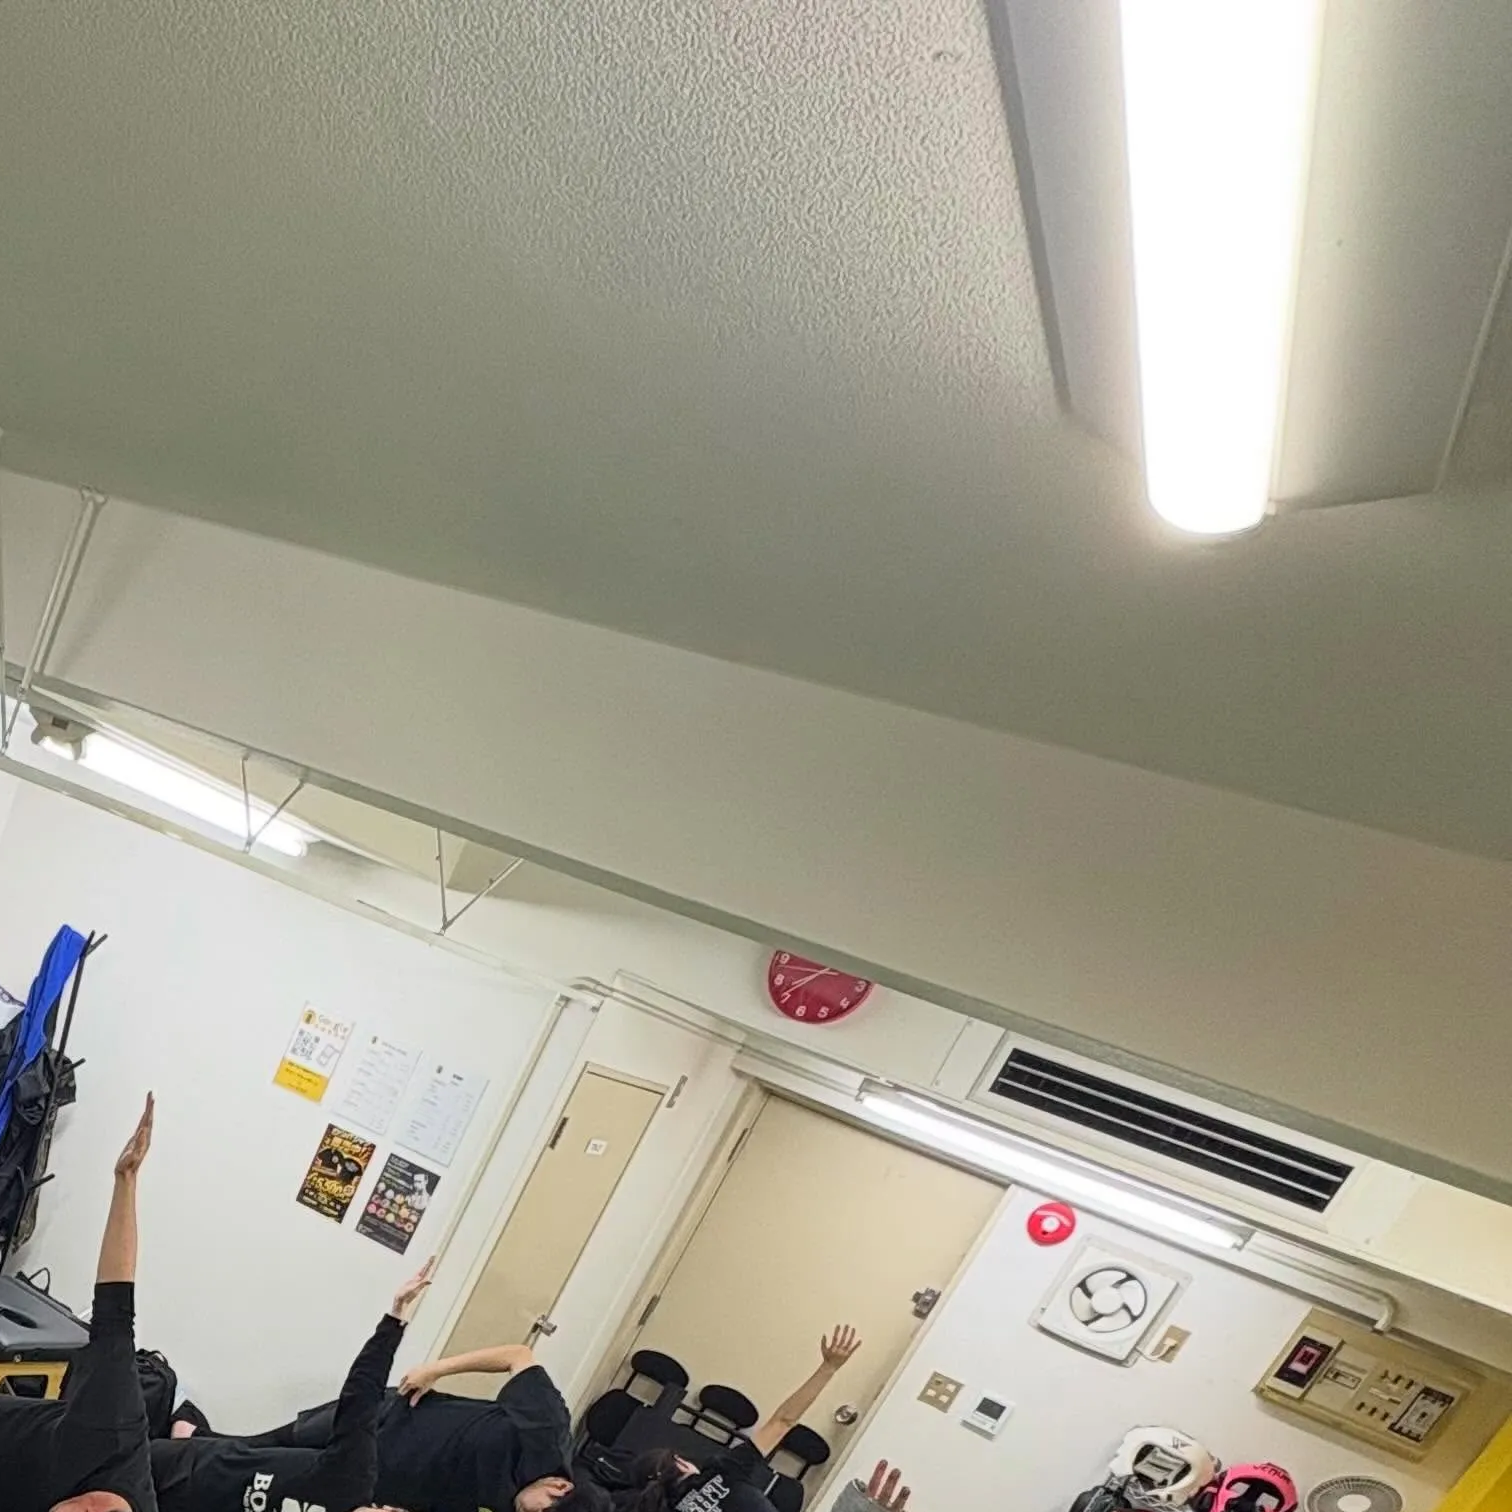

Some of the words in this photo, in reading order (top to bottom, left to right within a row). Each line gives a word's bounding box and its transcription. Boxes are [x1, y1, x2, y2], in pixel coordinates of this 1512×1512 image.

[840, 997, 850, 1008] 4
[795, 1005, 807, 1017] 6
[817, 1006, 829, 1018] 5
